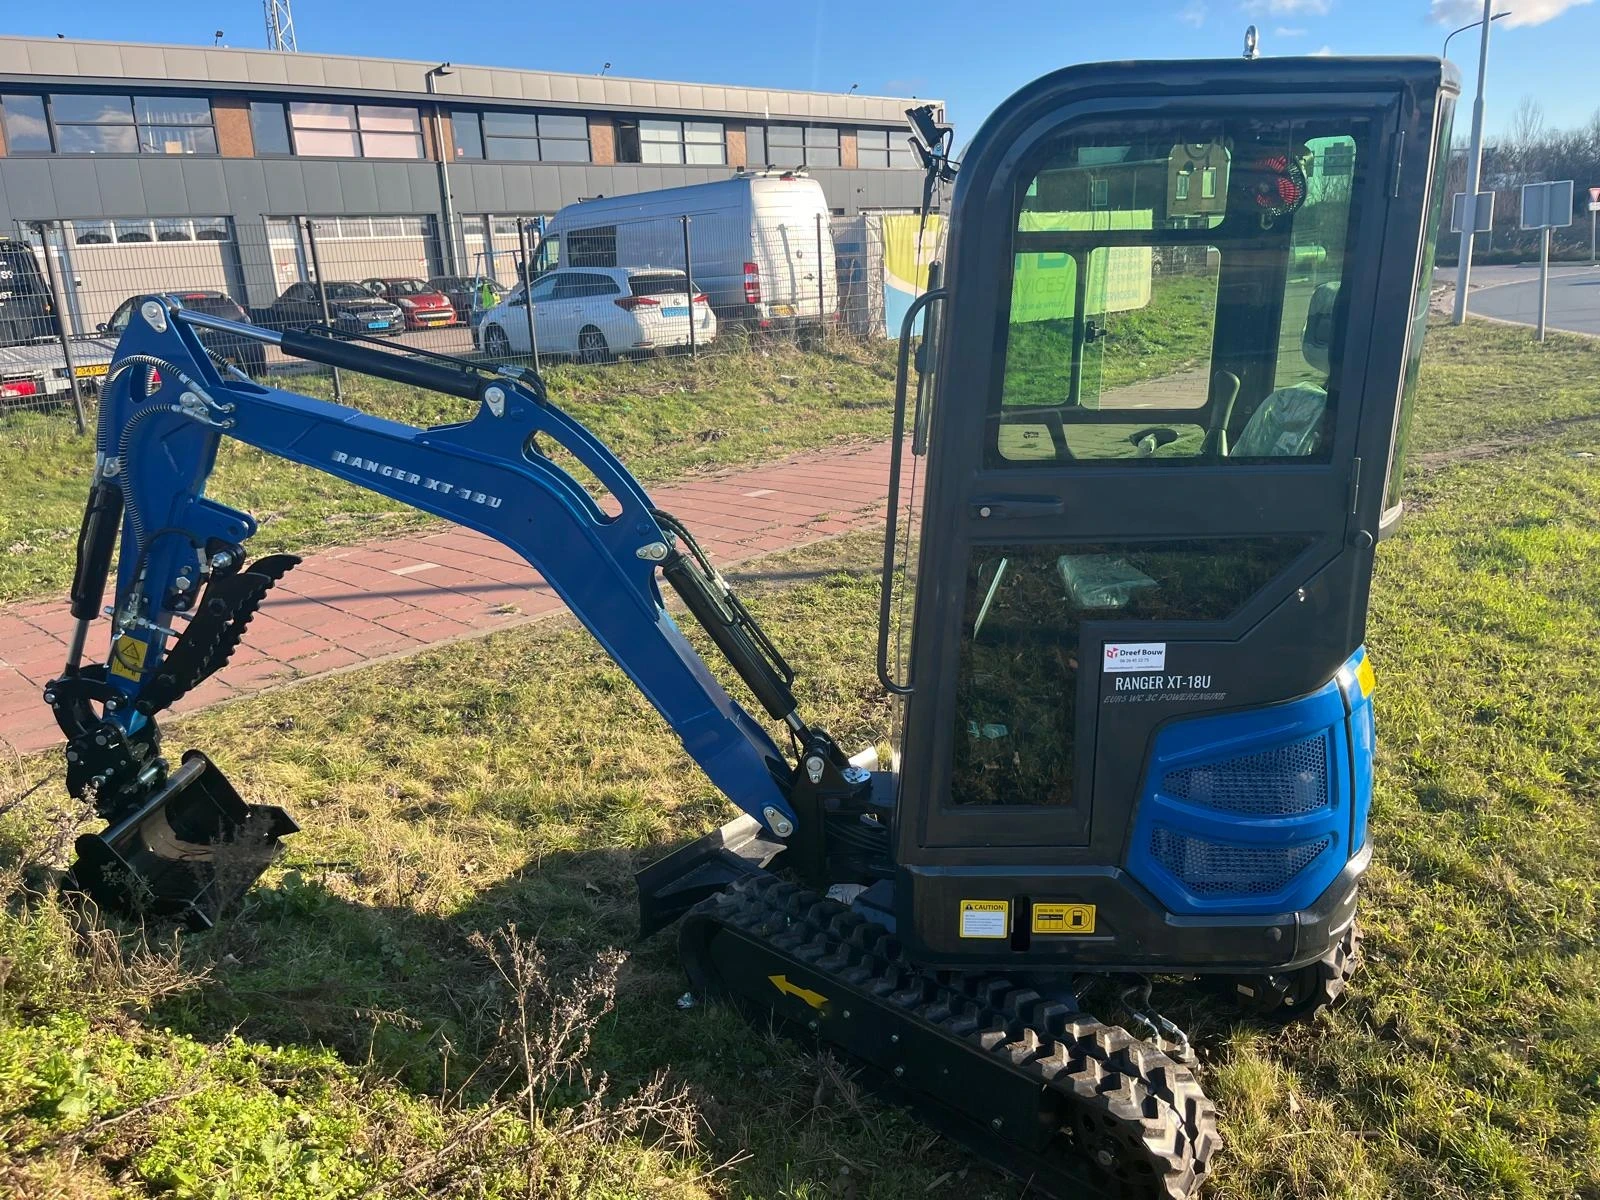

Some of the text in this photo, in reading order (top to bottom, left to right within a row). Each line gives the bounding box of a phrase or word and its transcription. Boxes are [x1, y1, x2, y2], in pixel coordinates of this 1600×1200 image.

[331, 450, 421, 486] RANGER
[1115, 675, 1212, 691] RANGER XT-18U
